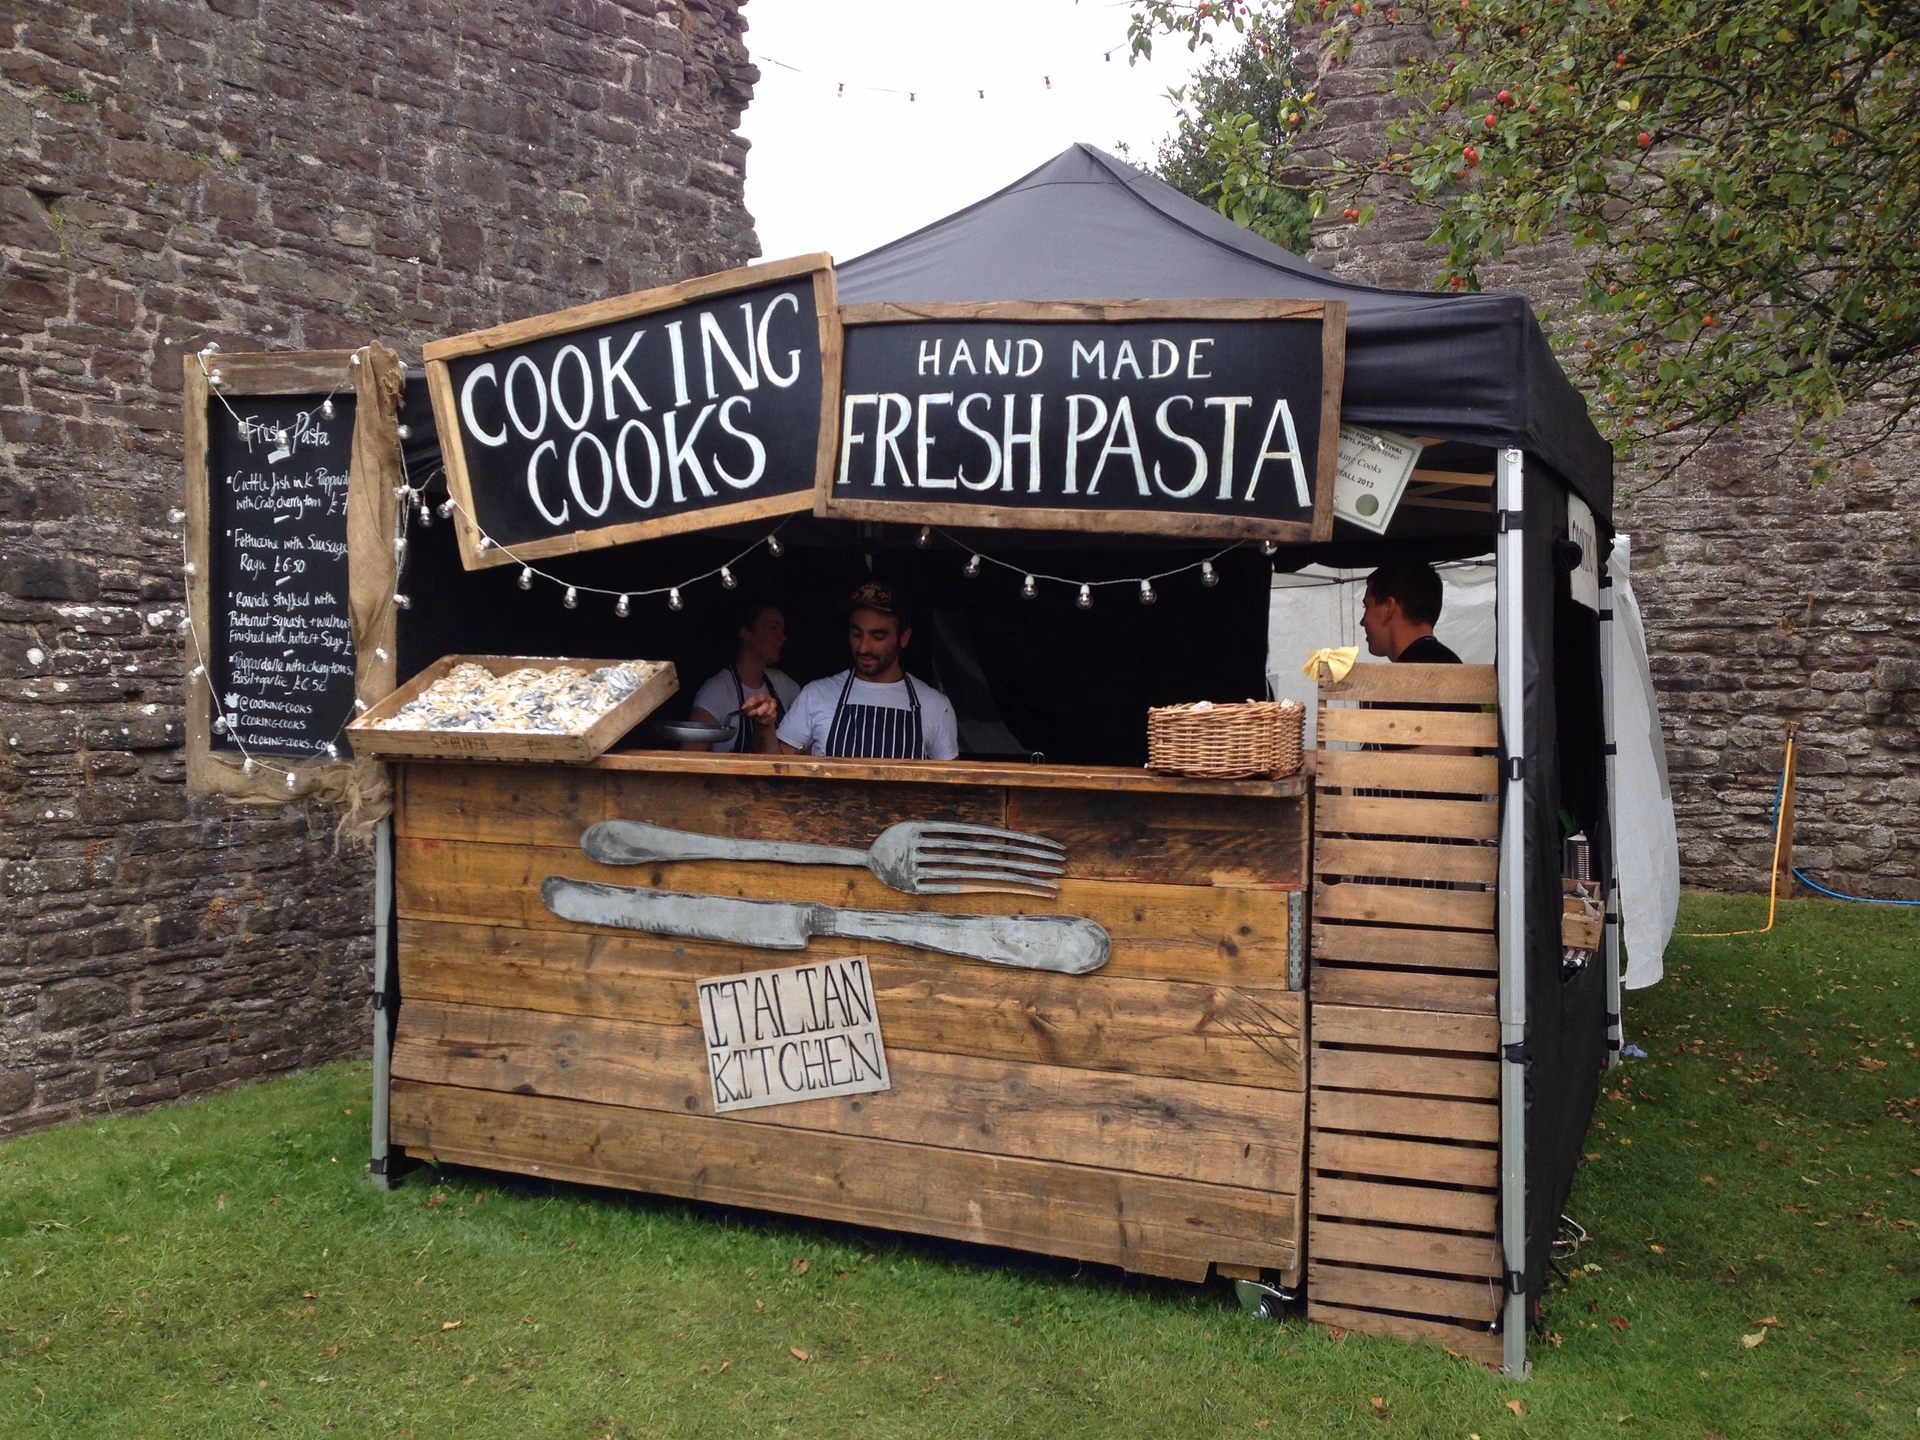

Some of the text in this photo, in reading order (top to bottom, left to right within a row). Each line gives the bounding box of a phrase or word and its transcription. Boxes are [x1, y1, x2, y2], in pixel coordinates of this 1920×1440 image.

[460, 293, 801, 447] COOKING
[918, 338, 1215, 381] HAND MADE
[292, 411, 330, 454] Pasta
[836, 390, 1313, 508] FRESH PASTA
[527, 396, 767, 527] COOKS
[1357, 458, 1382, 474] Cooks
[1357, 477, 1374, 489] 2013
[283, 535, 304, 550] with
[314, 591, 338, 605] with
[700, 960, 872, 1049] ITALIAN
[711, 1032, 883, 1104] KITCHEN
